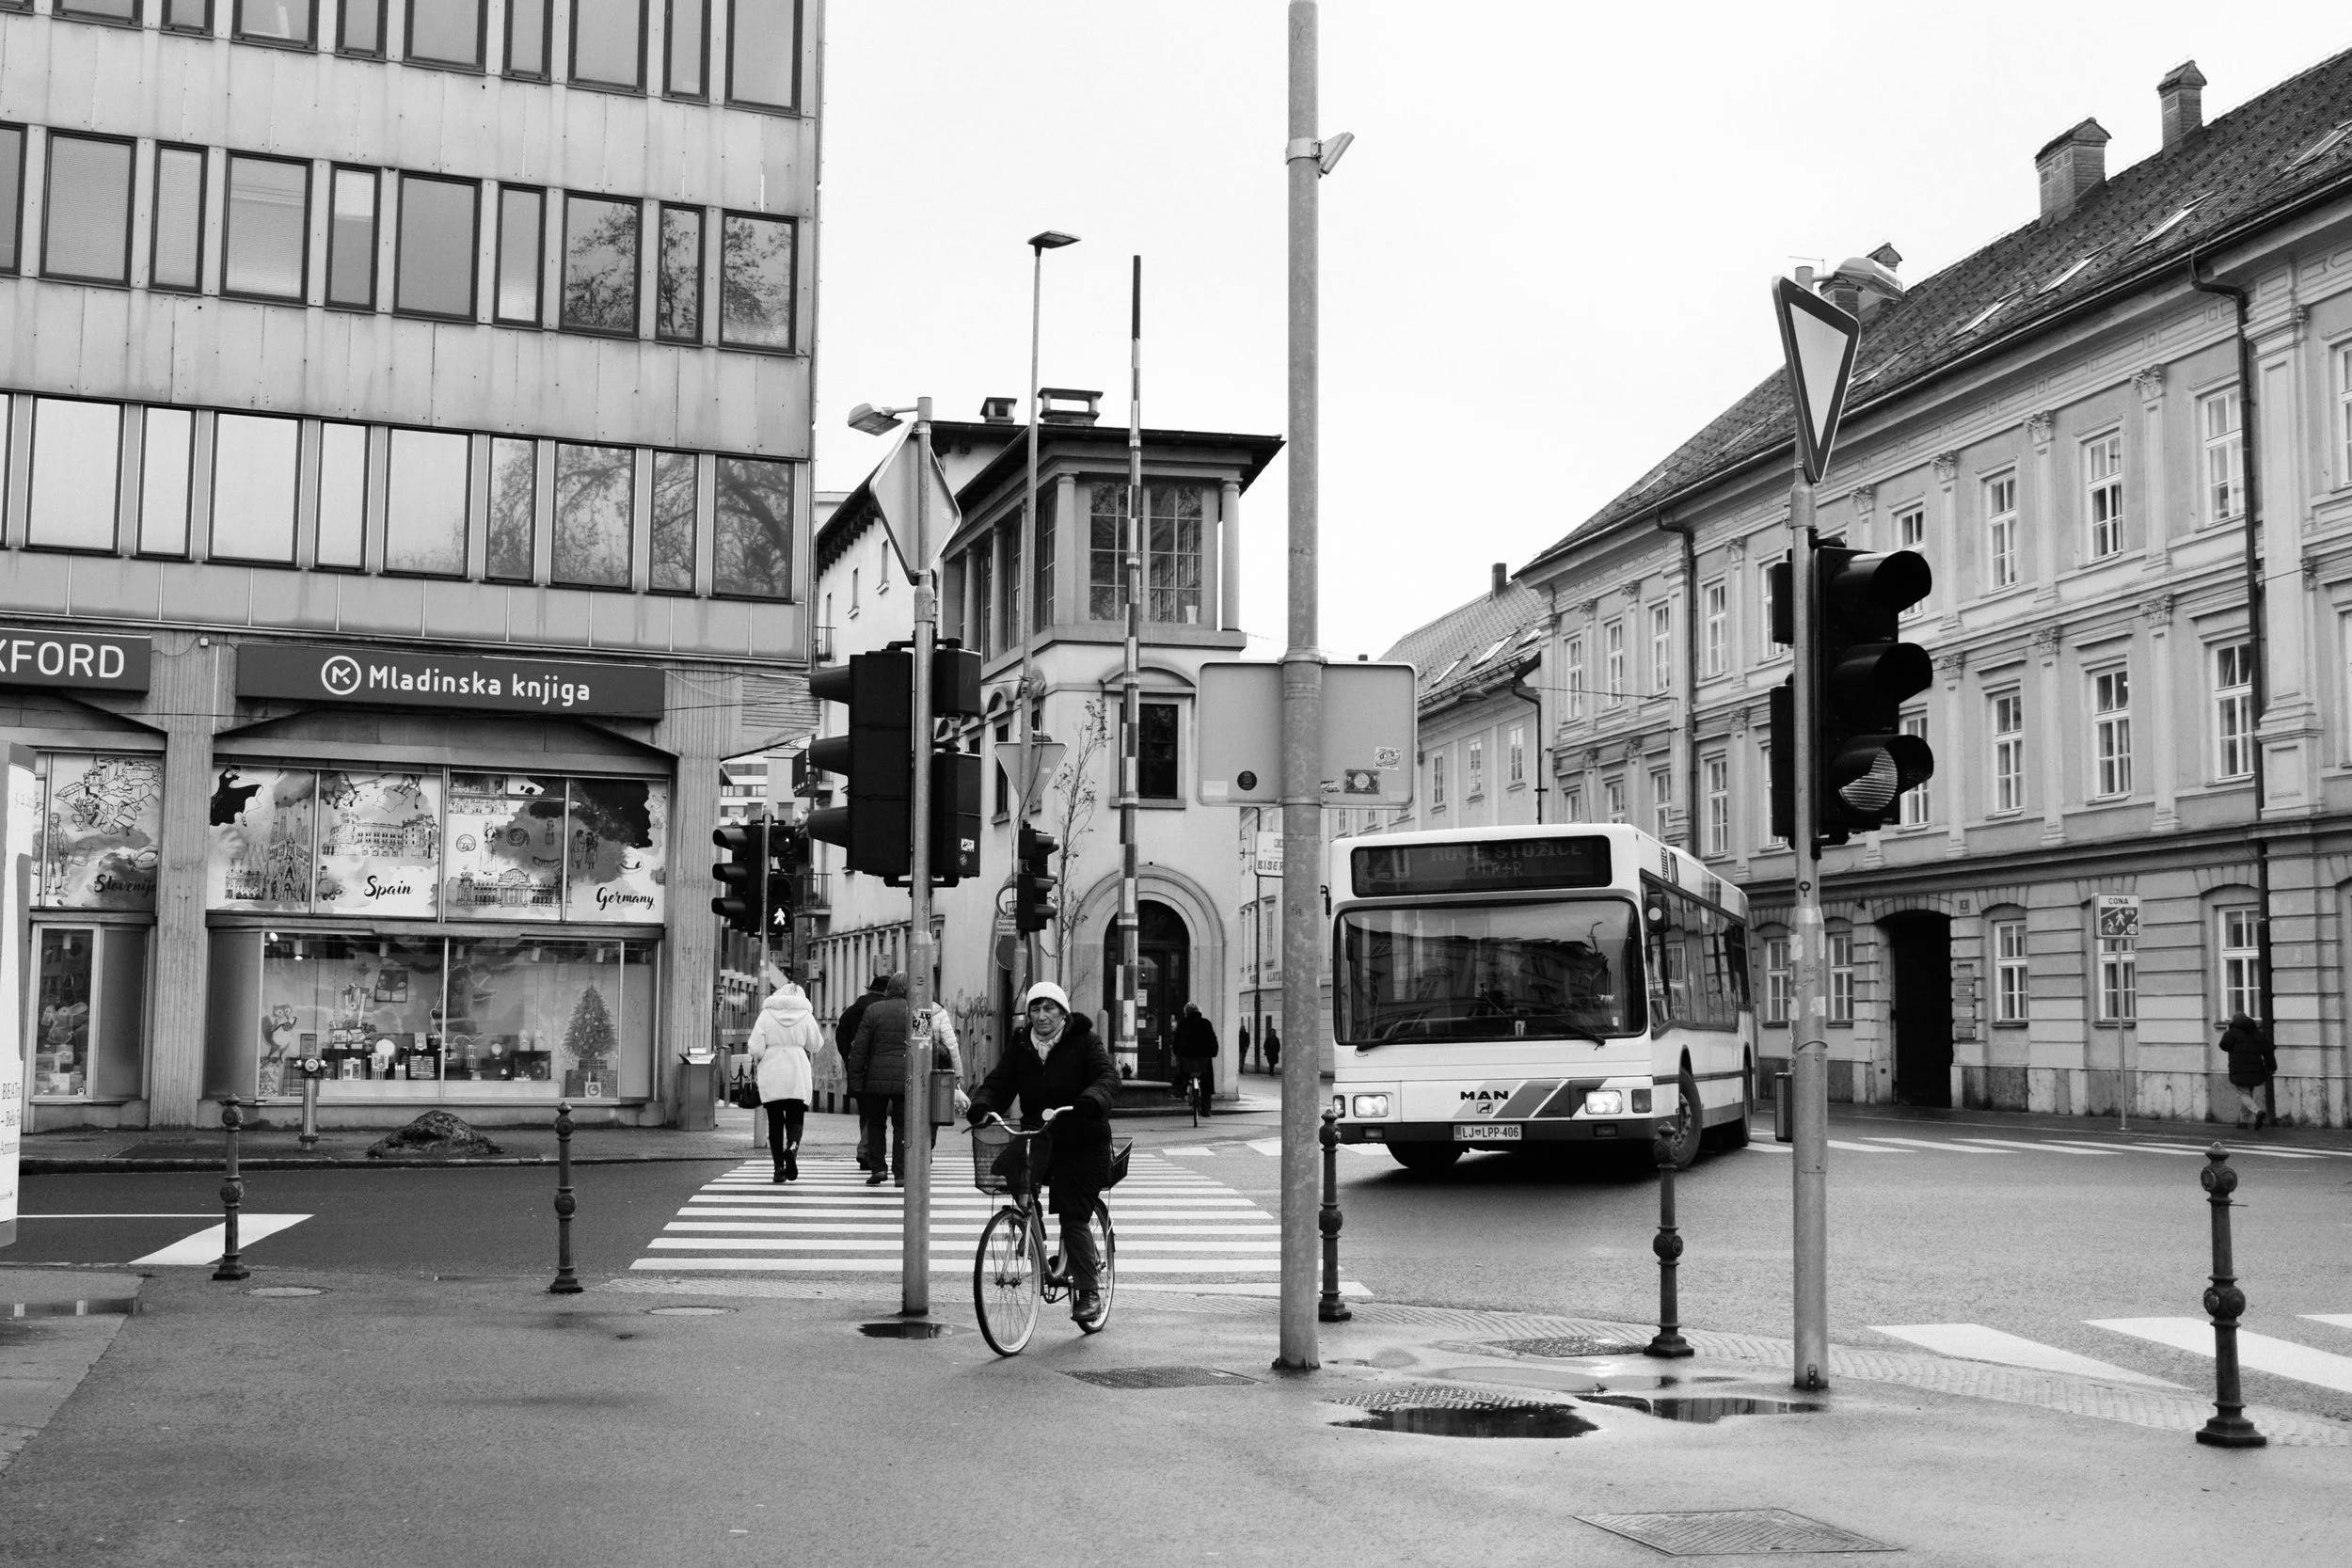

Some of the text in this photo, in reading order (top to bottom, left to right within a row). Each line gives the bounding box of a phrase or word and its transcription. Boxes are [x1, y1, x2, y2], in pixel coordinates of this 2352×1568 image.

[369, 664, 501, 695] Mladinska
[512, 673, 590, 706] knjiga
[363, 875, 414, 900] Spain
[596, 886, 656, 911] Germany
[1460, 1090, 1509, 1101] MAN
[1462, 1126, 1519, 1138] LJ LPP-406
